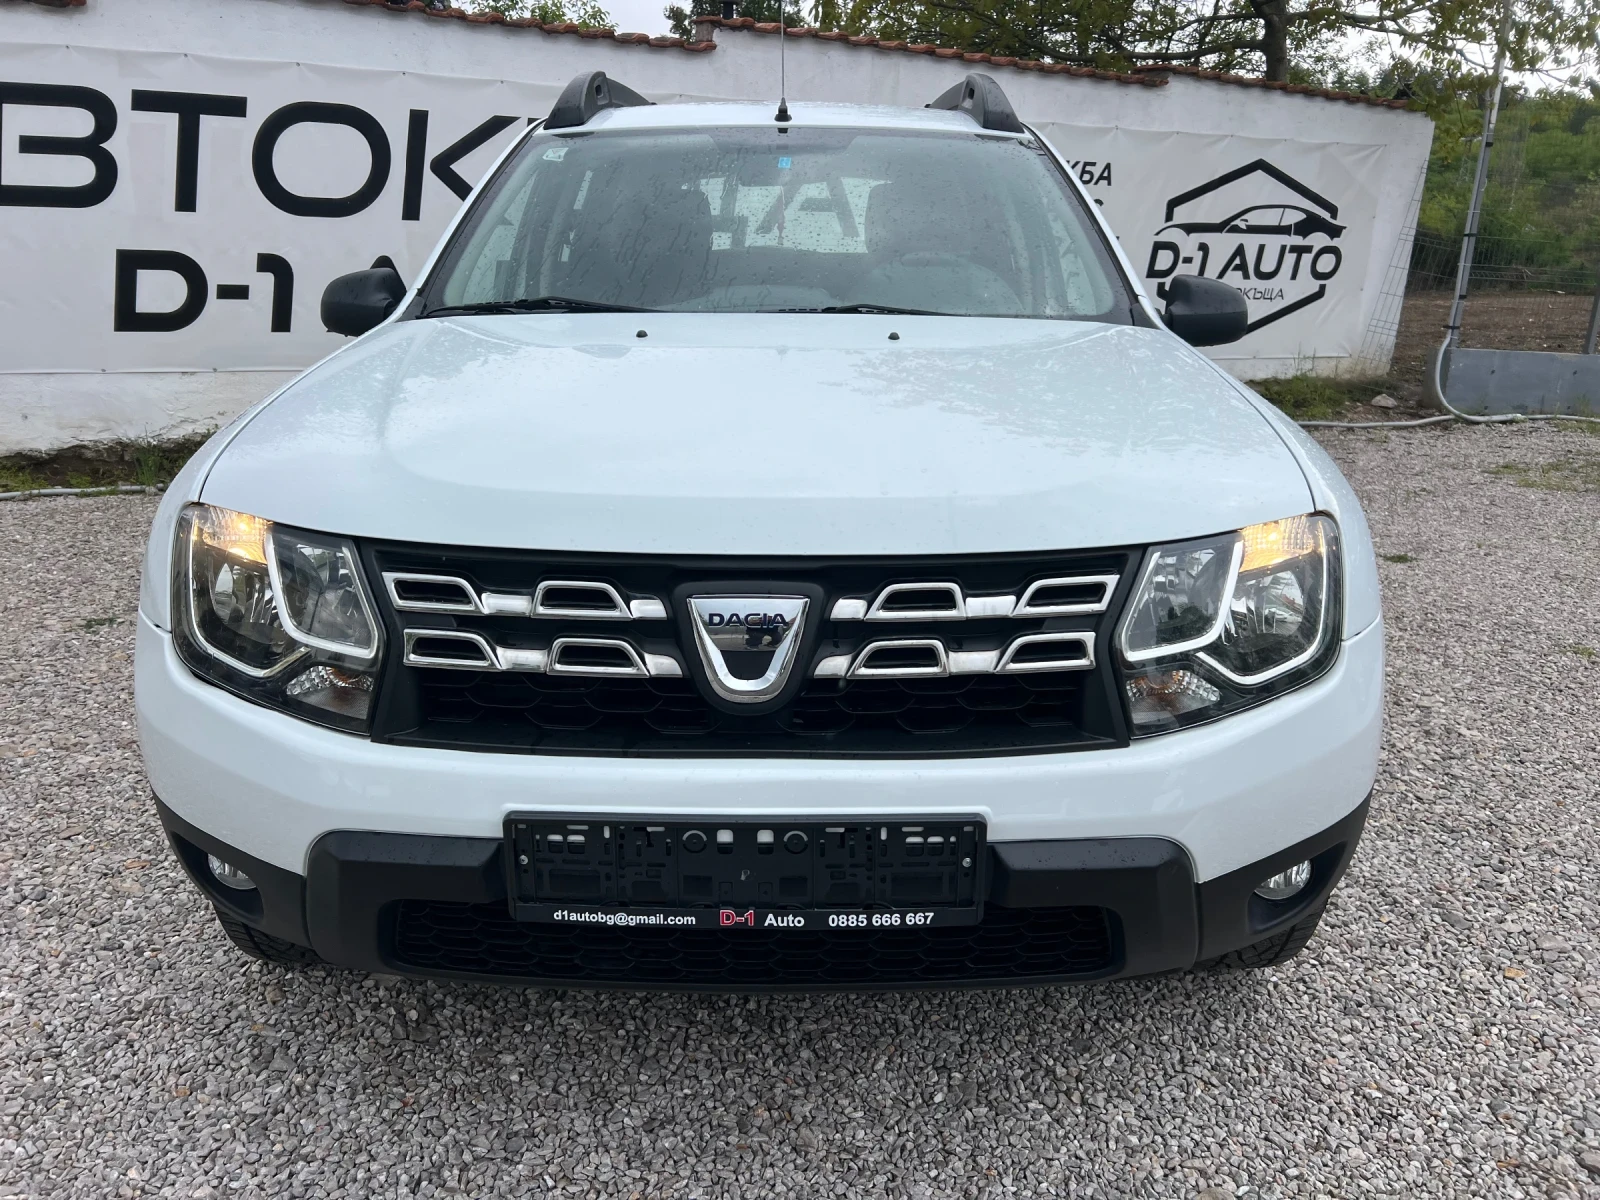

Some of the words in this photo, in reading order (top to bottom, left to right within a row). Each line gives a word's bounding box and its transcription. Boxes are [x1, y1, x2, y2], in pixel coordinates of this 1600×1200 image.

[0, 81, 541, 222] ВТОК
[1146, 241, 1210, 279] D-1
[1216, 242, 1342, 281] AUTO
[114, 248, 294, 333] D-1
[708, 613, 790, 628] DACIA
[553, 910, 696, 926] d1autobg@gmail.com
[719, 909, 755, 926] D-1
[764, 913, 805, 927] Auto
[828, 914, 868, 927] 0885
[872, 913, 901, 926] 666
[905, 912, 935, 925] 667
